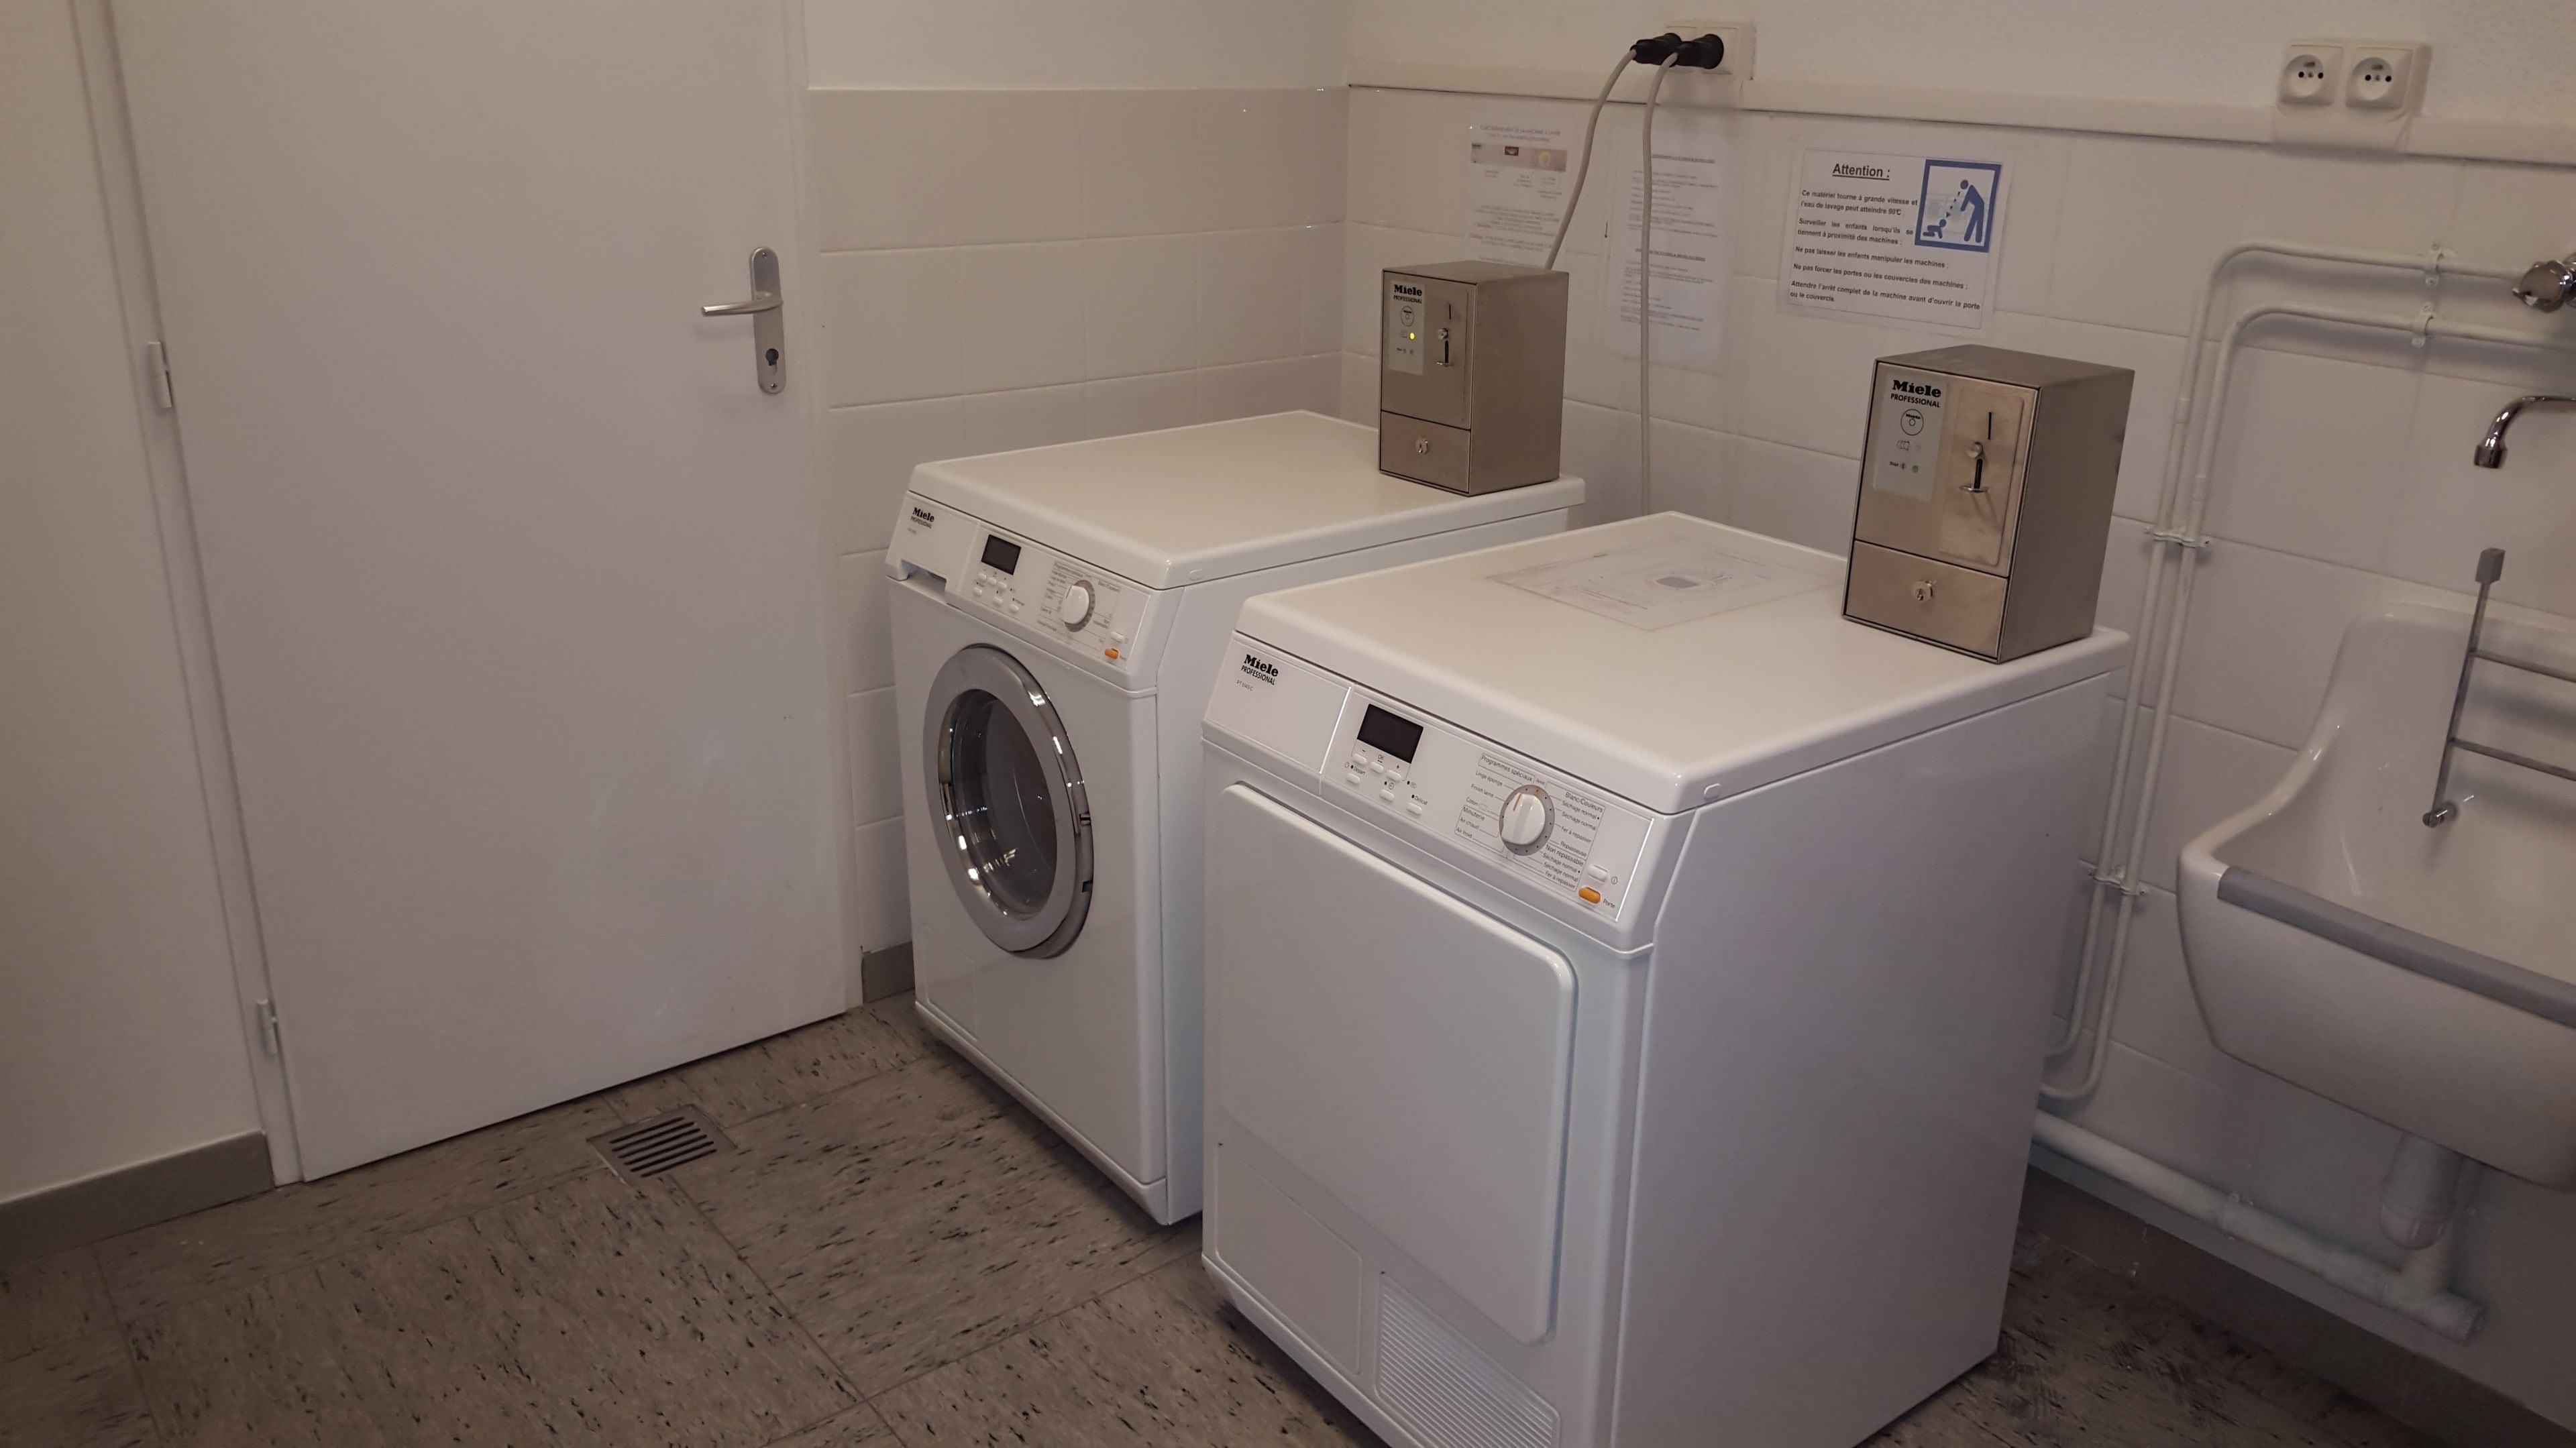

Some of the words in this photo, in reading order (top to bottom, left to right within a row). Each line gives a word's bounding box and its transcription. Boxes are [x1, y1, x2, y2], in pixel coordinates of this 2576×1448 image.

[1833, 163, 1883, 178] Attention
[1845, 222, 1868, 230] enfants
[1872, 225, 1900, 234] lorsqu'ils
[1869, 236, 1898, 245] machines
[1817, 248, 1836, 256] laisser
[1847, 252, 1870, 260] enfants
[1871, 254, 1903, 264] manipuler
[1915, 259, 1945, 268] machines
[1815, 266, 1832, 274] forcer
[1843, 269, 1862, 277] portes
[1884, 273, 1918, 284] couvercles
[1932, 280, 1964, 289] machines
[1394, 284, 1422, 296] Miele
[1791, 280, 1817, 289] Attendre
[1837, 285, 1862, 296] complet
[1880, 291, 1907, 300] machine
[1909, 295, 1926, 303] avant
[1927, 296, 1953, 307] d'ouvrir
[1963, 301, 1980, 311] porte
[1892, 380, 1941, 398] Miele
[1890, 393, 1941, 408] PROFESSIONAL
[912, 507, 934, 522] Miele
[1244, 654, 1279, 677] Miele
[1241, 665, 1276, 685] PROFESSIONAL
[1476, 771, 1487, 779] Linge
[1481, 755, 1511, 773] Programmes
[1511, 767, 1533, 781] spéciaux
[1466, 797, 1478, 806] Coton
[1565, 791, 1603, 813] Blanc/Couleurs
[1464, 806, 1485, 821] Minuterie
[1578, 807, 1597, 820] normal
[1466, 820, 1479, 830] chaud
[1578, 818, 1597, 831] normal
[1545, 844, 1556, 854] Non
[1557, 849, 1584, 867] repassable
[1603, 899, 1616, 909] Porte
